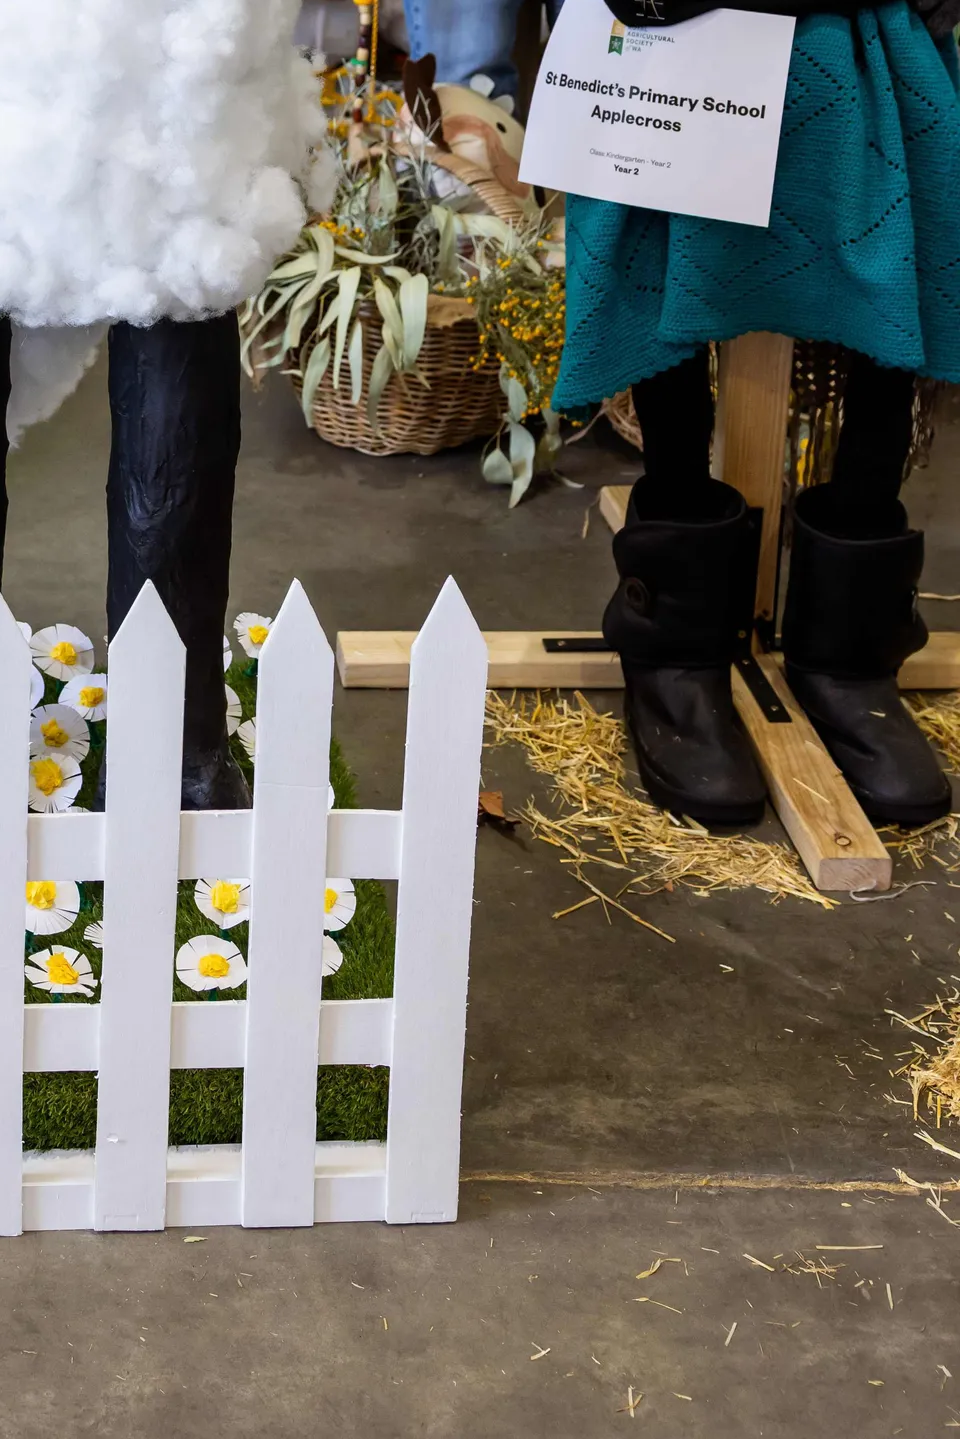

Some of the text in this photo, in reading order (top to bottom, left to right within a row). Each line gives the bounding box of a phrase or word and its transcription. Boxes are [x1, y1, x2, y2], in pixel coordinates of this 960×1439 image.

[626, 31, 675, 43] AGRICULTURAL
[626, 38, 654, 47] SOCIETY
[545, 71, 766, 119] St Benedict's Primary School
[591, 104, 682, 132] Applecross
[606, 152, 645, 164] Kindergarten
[650, 159, 666, 168] Year
[613, 163, 632, 174] Year
